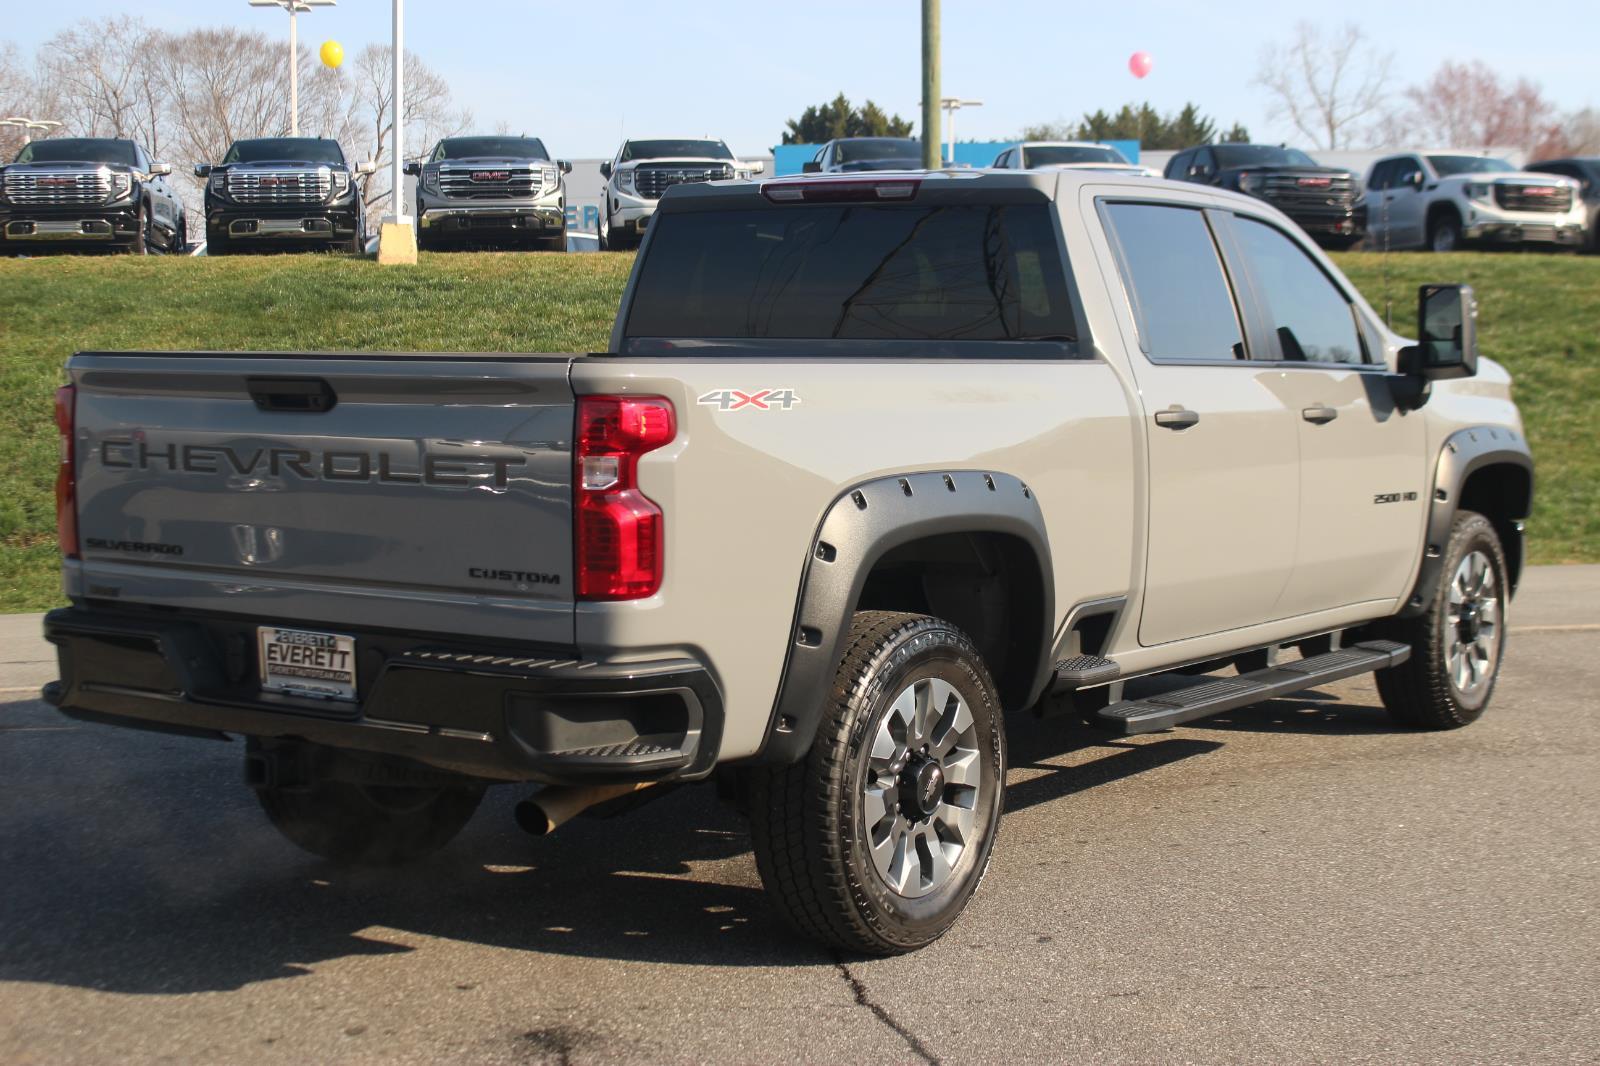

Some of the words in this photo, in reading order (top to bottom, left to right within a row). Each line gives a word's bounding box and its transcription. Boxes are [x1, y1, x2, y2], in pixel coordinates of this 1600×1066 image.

[101, 440, 527, 489] CHEVROLET
[86, 538, 183, 555] SILVERADO
[468, 567, 561, 584] CUSTOM
[267, 642, 350, 669] EVERETT
